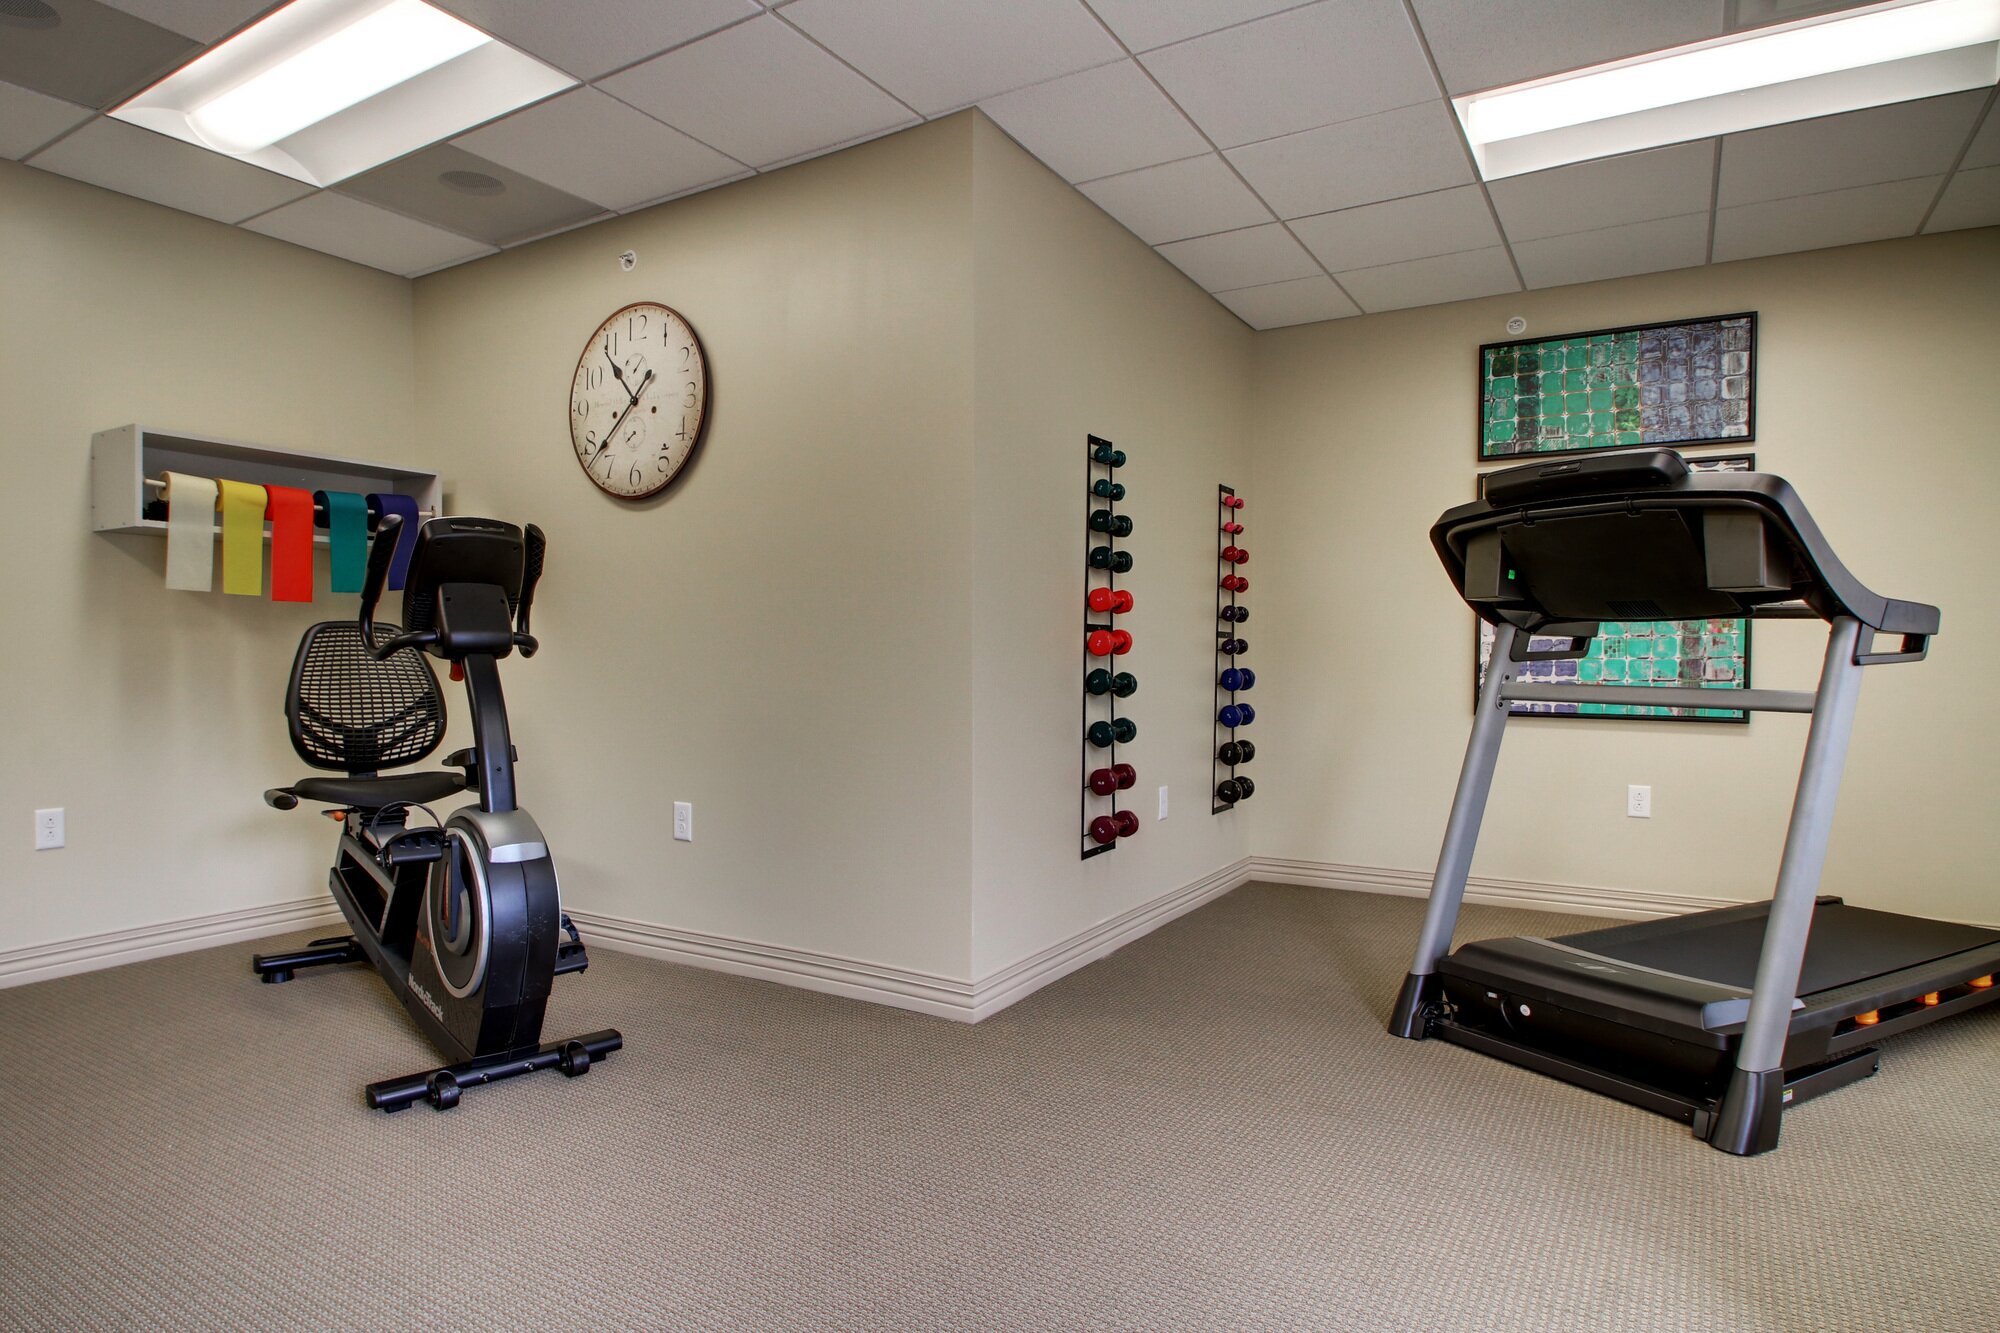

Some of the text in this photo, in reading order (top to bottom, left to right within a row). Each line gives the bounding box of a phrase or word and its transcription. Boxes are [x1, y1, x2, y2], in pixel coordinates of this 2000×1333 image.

[628, 314, 648, 342] 12
[605, 332, 617, 356] 11
[677, 346, 690, 374] 2
[585, 365, 602, 391] 10
[683, 381, 697, 409] 3
[577, 399, 589, 421] 9
[675, 416, 687, 441] 4
[584, 430, 597, 456] 8
[604, 454, 617, 480] 7
[657, 443, 670, 473] 5
[629, 459, 642, 487] 6
[408, 973, 443, 1022] NordicTrack
